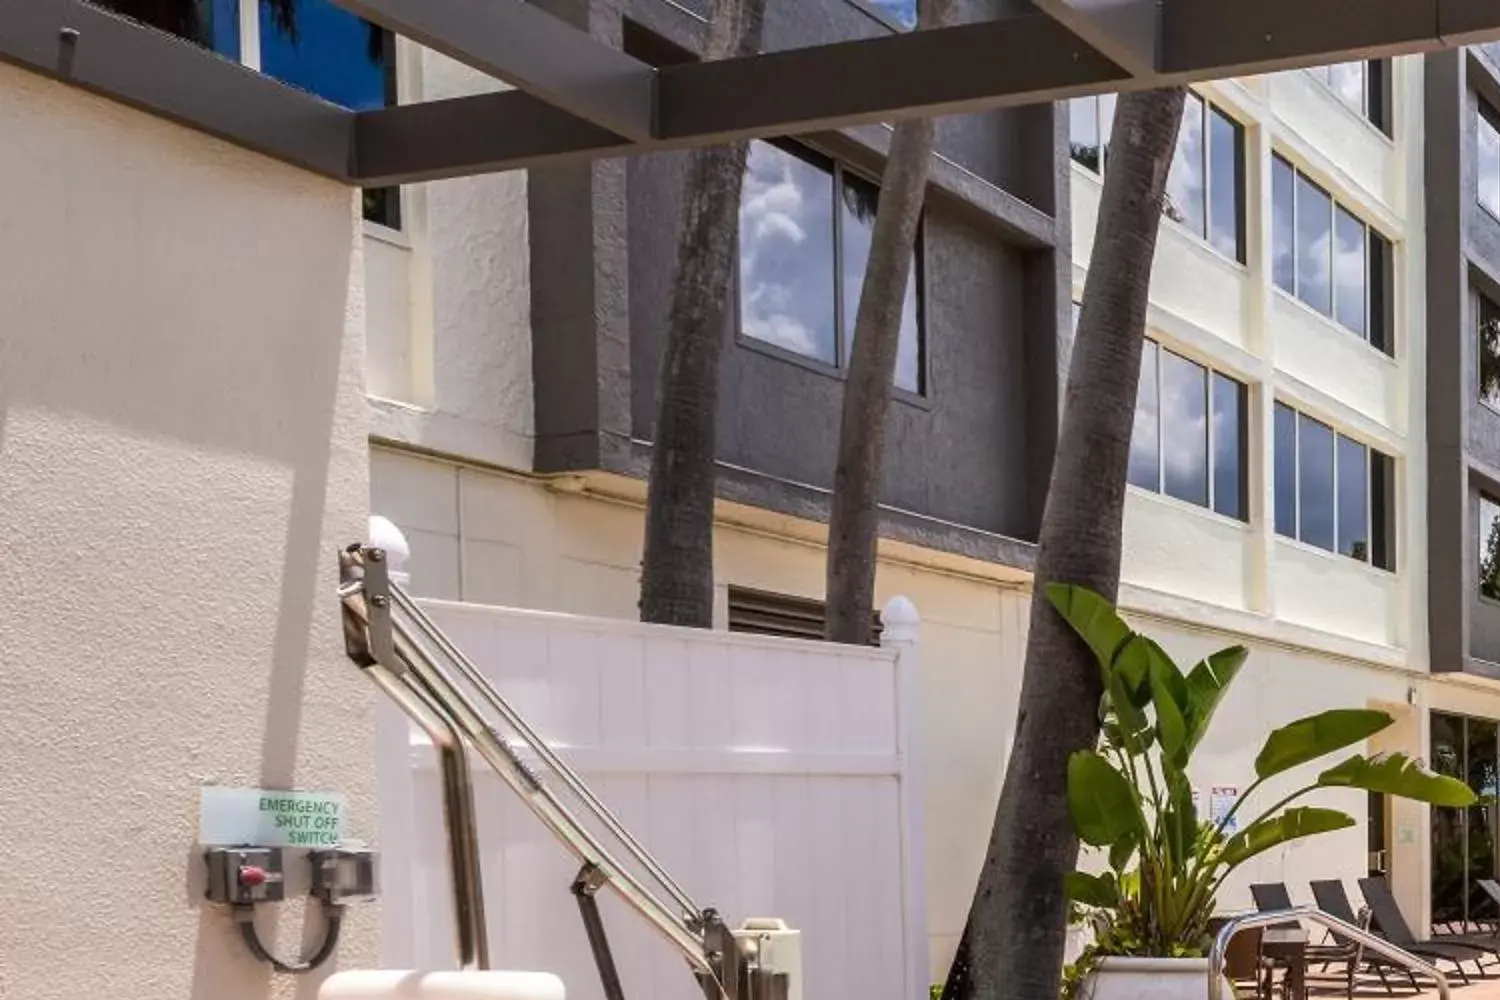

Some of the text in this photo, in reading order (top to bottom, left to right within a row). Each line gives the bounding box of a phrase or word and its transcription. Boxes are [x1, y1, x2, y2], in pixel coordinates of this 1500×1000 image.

[259, 798, 338, 814] EMERGENCY
[275, 815, 338, 829] SHUT OFF
[289, 830, 338, 844] SWITCH
